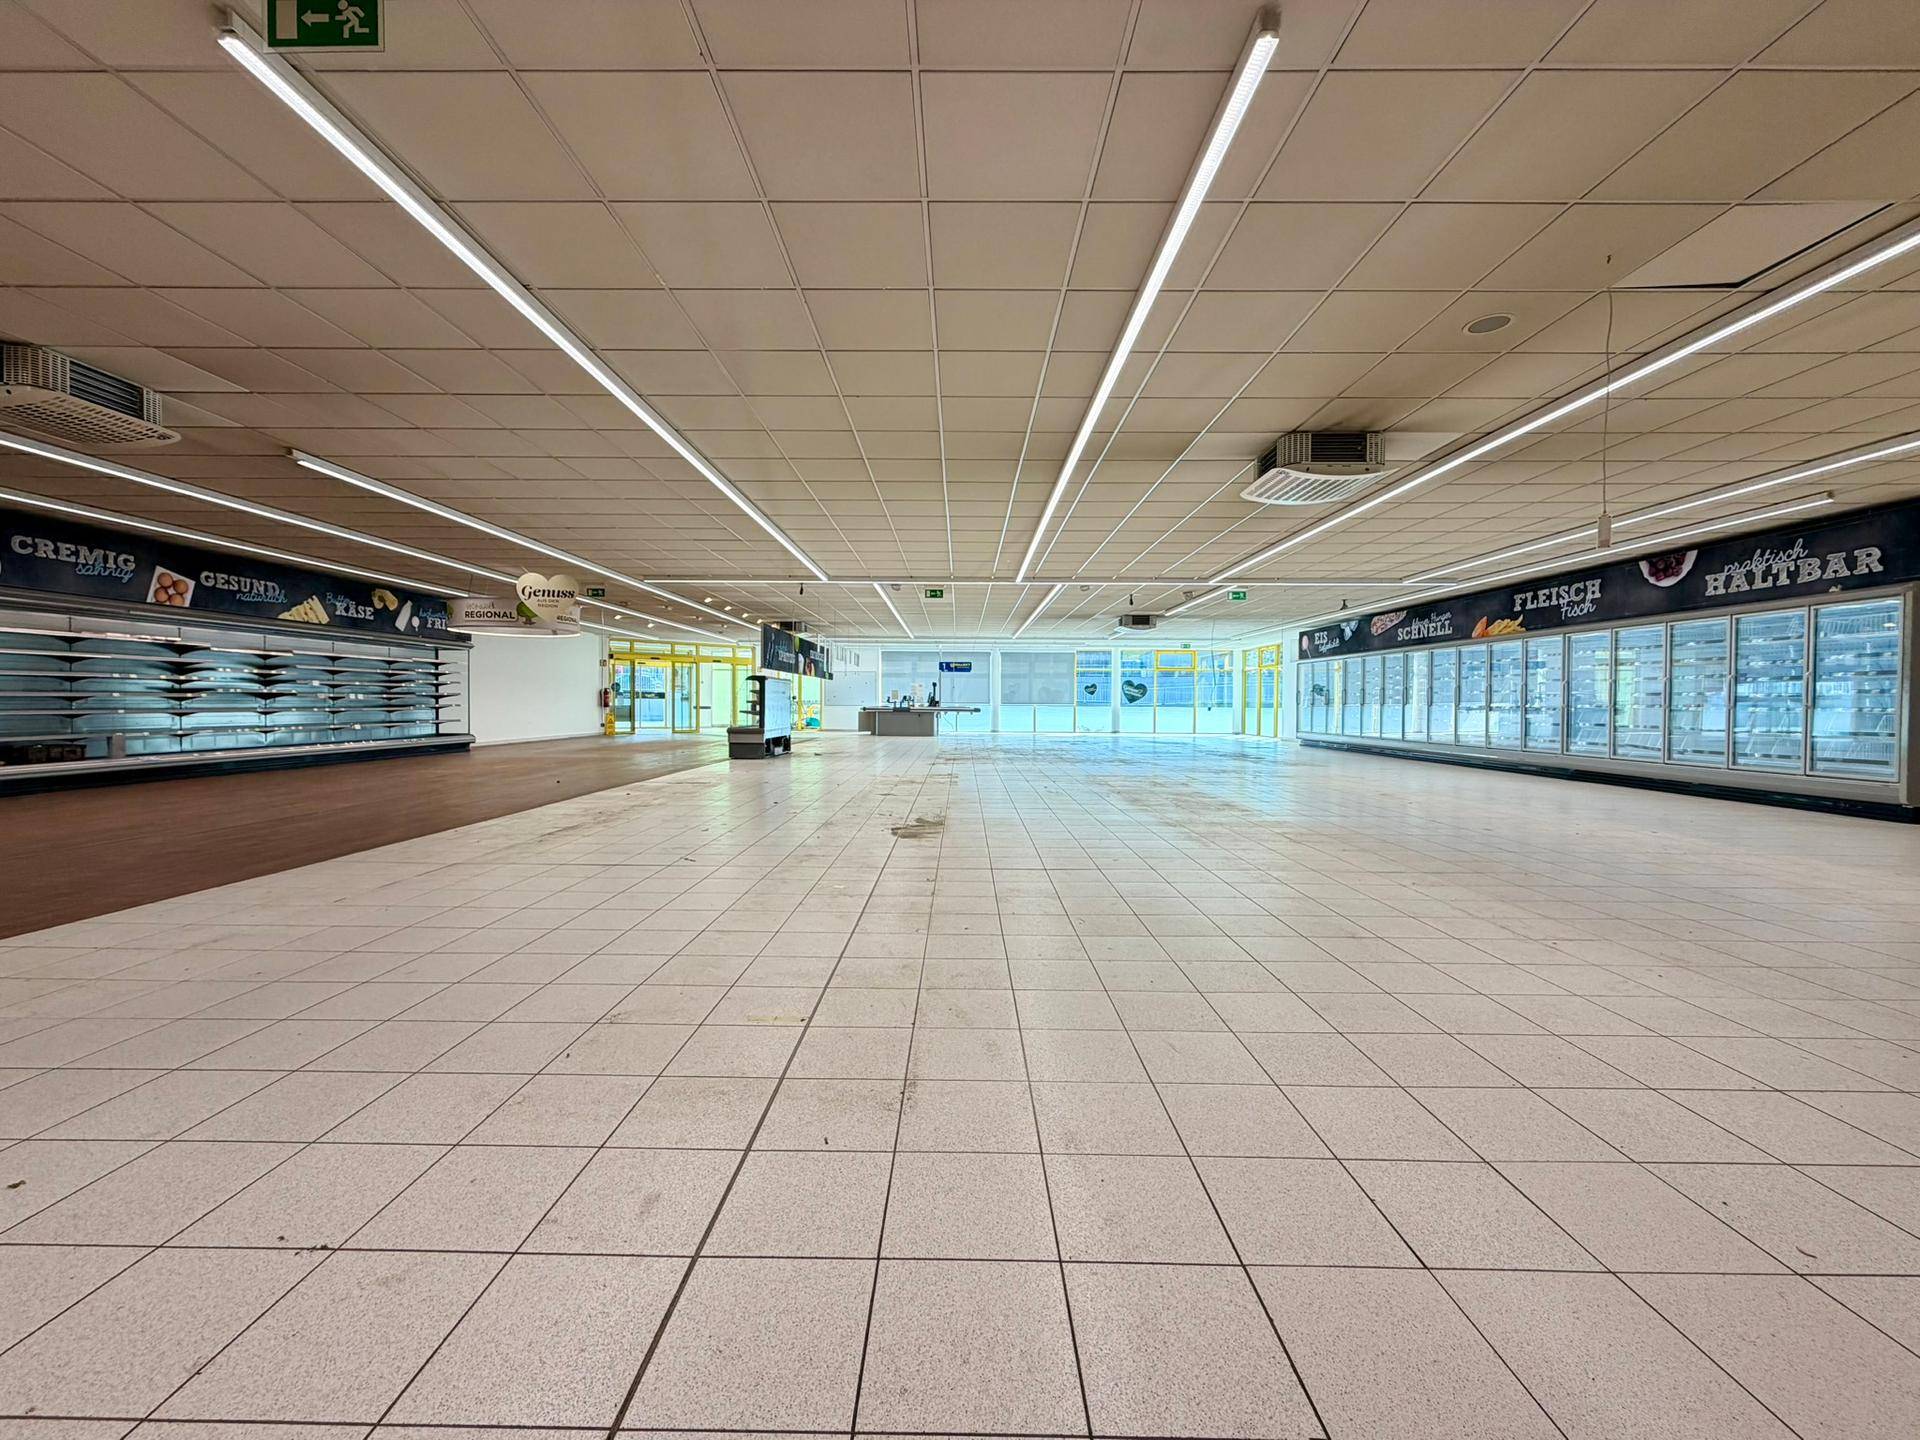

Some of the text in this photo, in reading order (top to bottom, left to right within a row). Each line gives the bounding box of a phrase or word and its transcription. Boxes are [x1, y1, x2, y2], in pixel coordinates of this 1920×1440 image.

[10, 535, 136, 570] CREMIG
[1724, 538, 1808, 576] praktisch
[200, 571, 280, 597] GESUND
[1705, 546, 1884, 597] HALTBAR
[521, 585, 576, 600] Genuss
[1513, 578, 1602, 612] FLEISCH
[335, 601, 375, 620] KÄSE
[464, 610, 516, 620] REGIONAL
[1560, 595, 1597, 620] Fisch
[1314, 631, 1328, 645] EIS
[1397, 620, 1453, 641] SCHNELL
